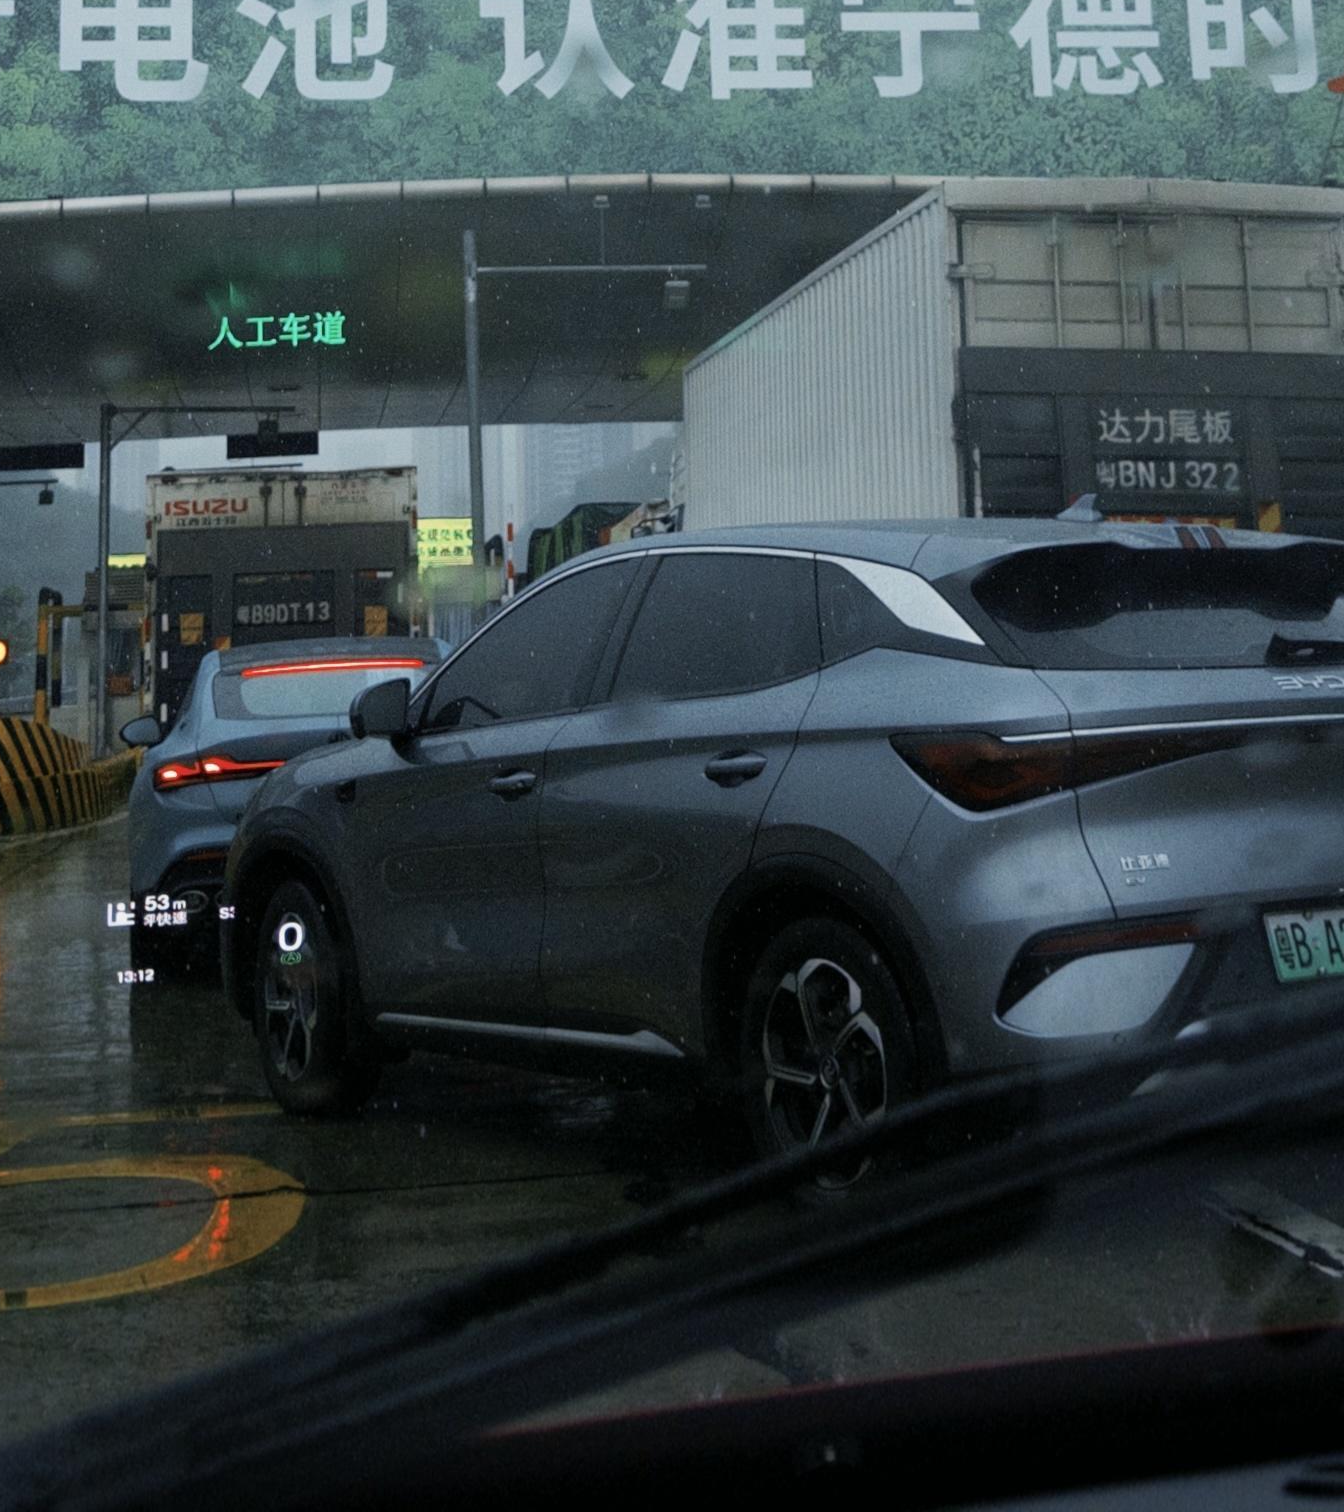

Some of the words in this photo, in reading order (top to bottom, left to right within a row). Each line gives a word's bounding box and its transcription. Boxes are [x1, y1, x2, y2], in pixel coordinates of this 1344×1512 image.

[208, 310, 346, 350] 人工车道
[1098, 408, 1234, 444] 达力尾板
[164, 498, 249, 516] ISUZU
[144, 894, 170, 911] 53
[172, 900, 187, 910] m
[117, 969, 155, 984] 13:12
